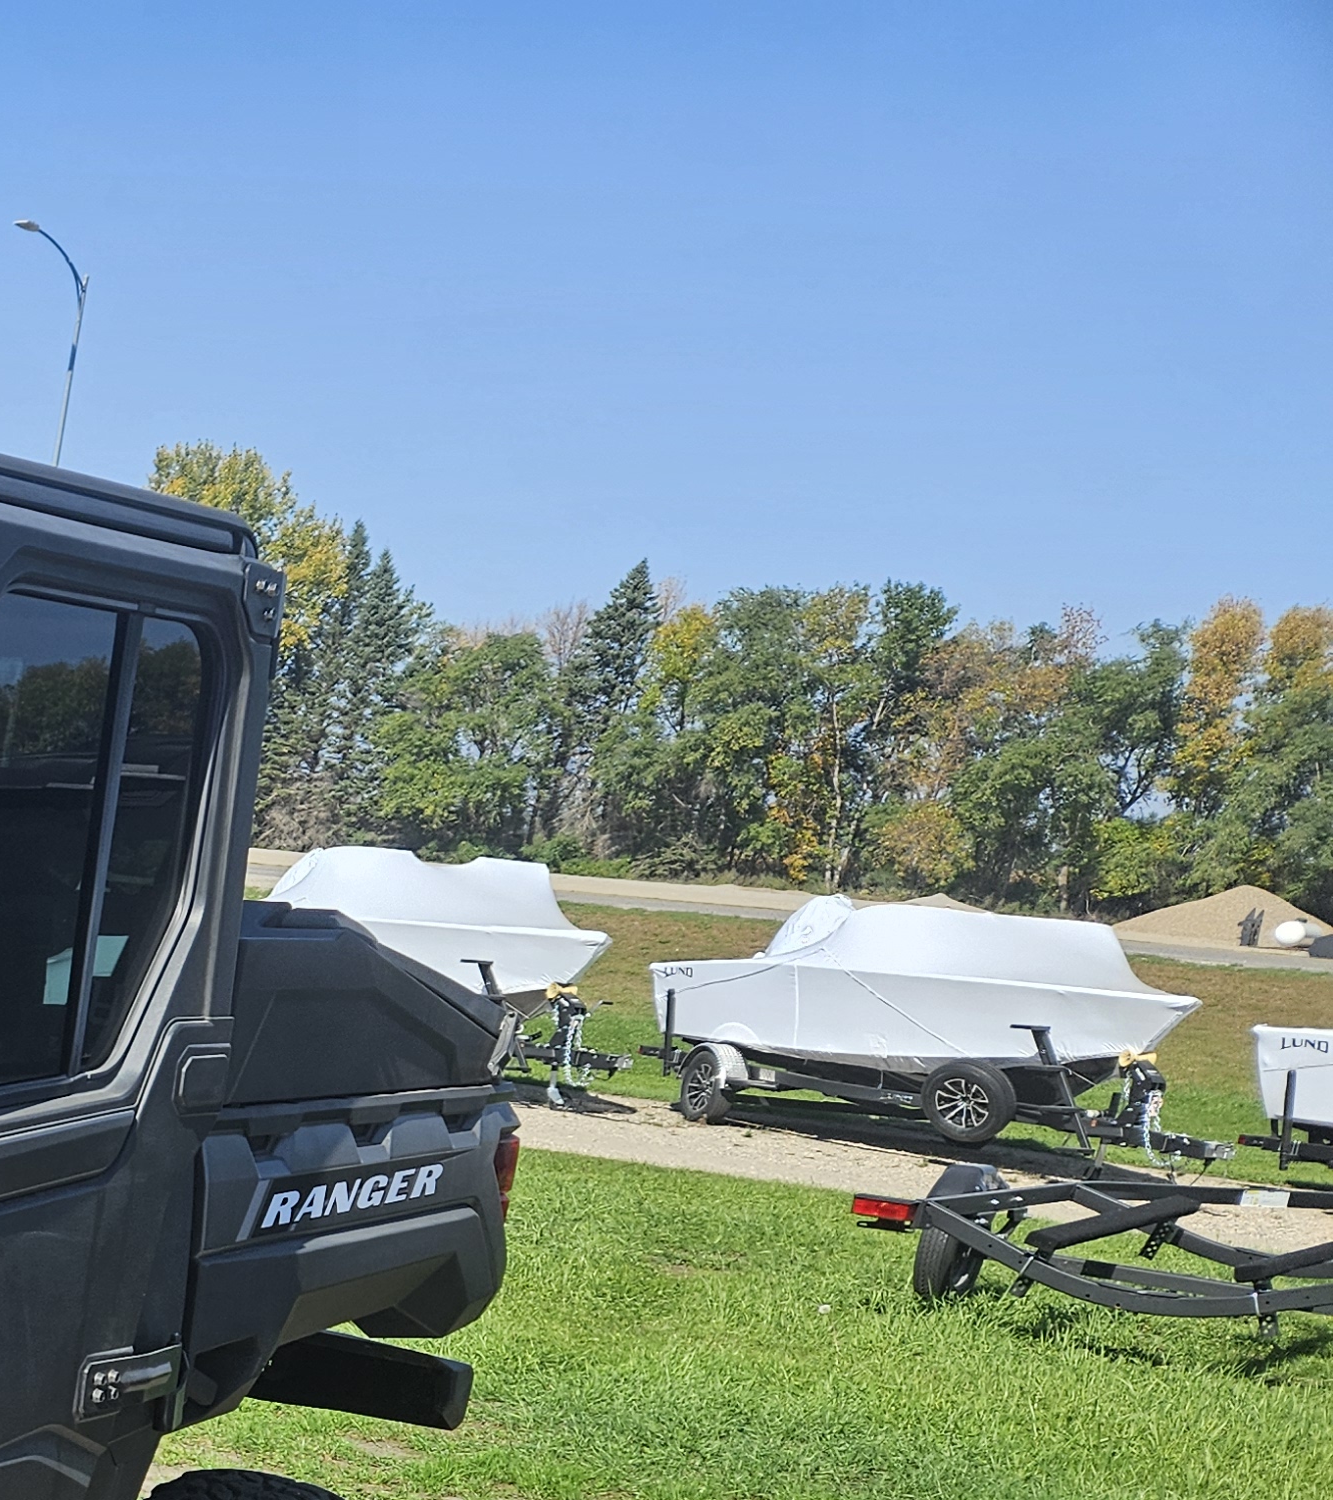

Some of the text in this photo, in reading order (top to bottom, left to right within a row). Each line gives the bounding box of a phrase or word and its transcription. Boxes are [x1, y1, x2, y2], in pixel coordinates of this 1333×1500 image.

[661, 967, 693, 978] LUND
[1280, 1036, 1329, 1053] LUND
[260, 1163, 445, 1229] RANGER
